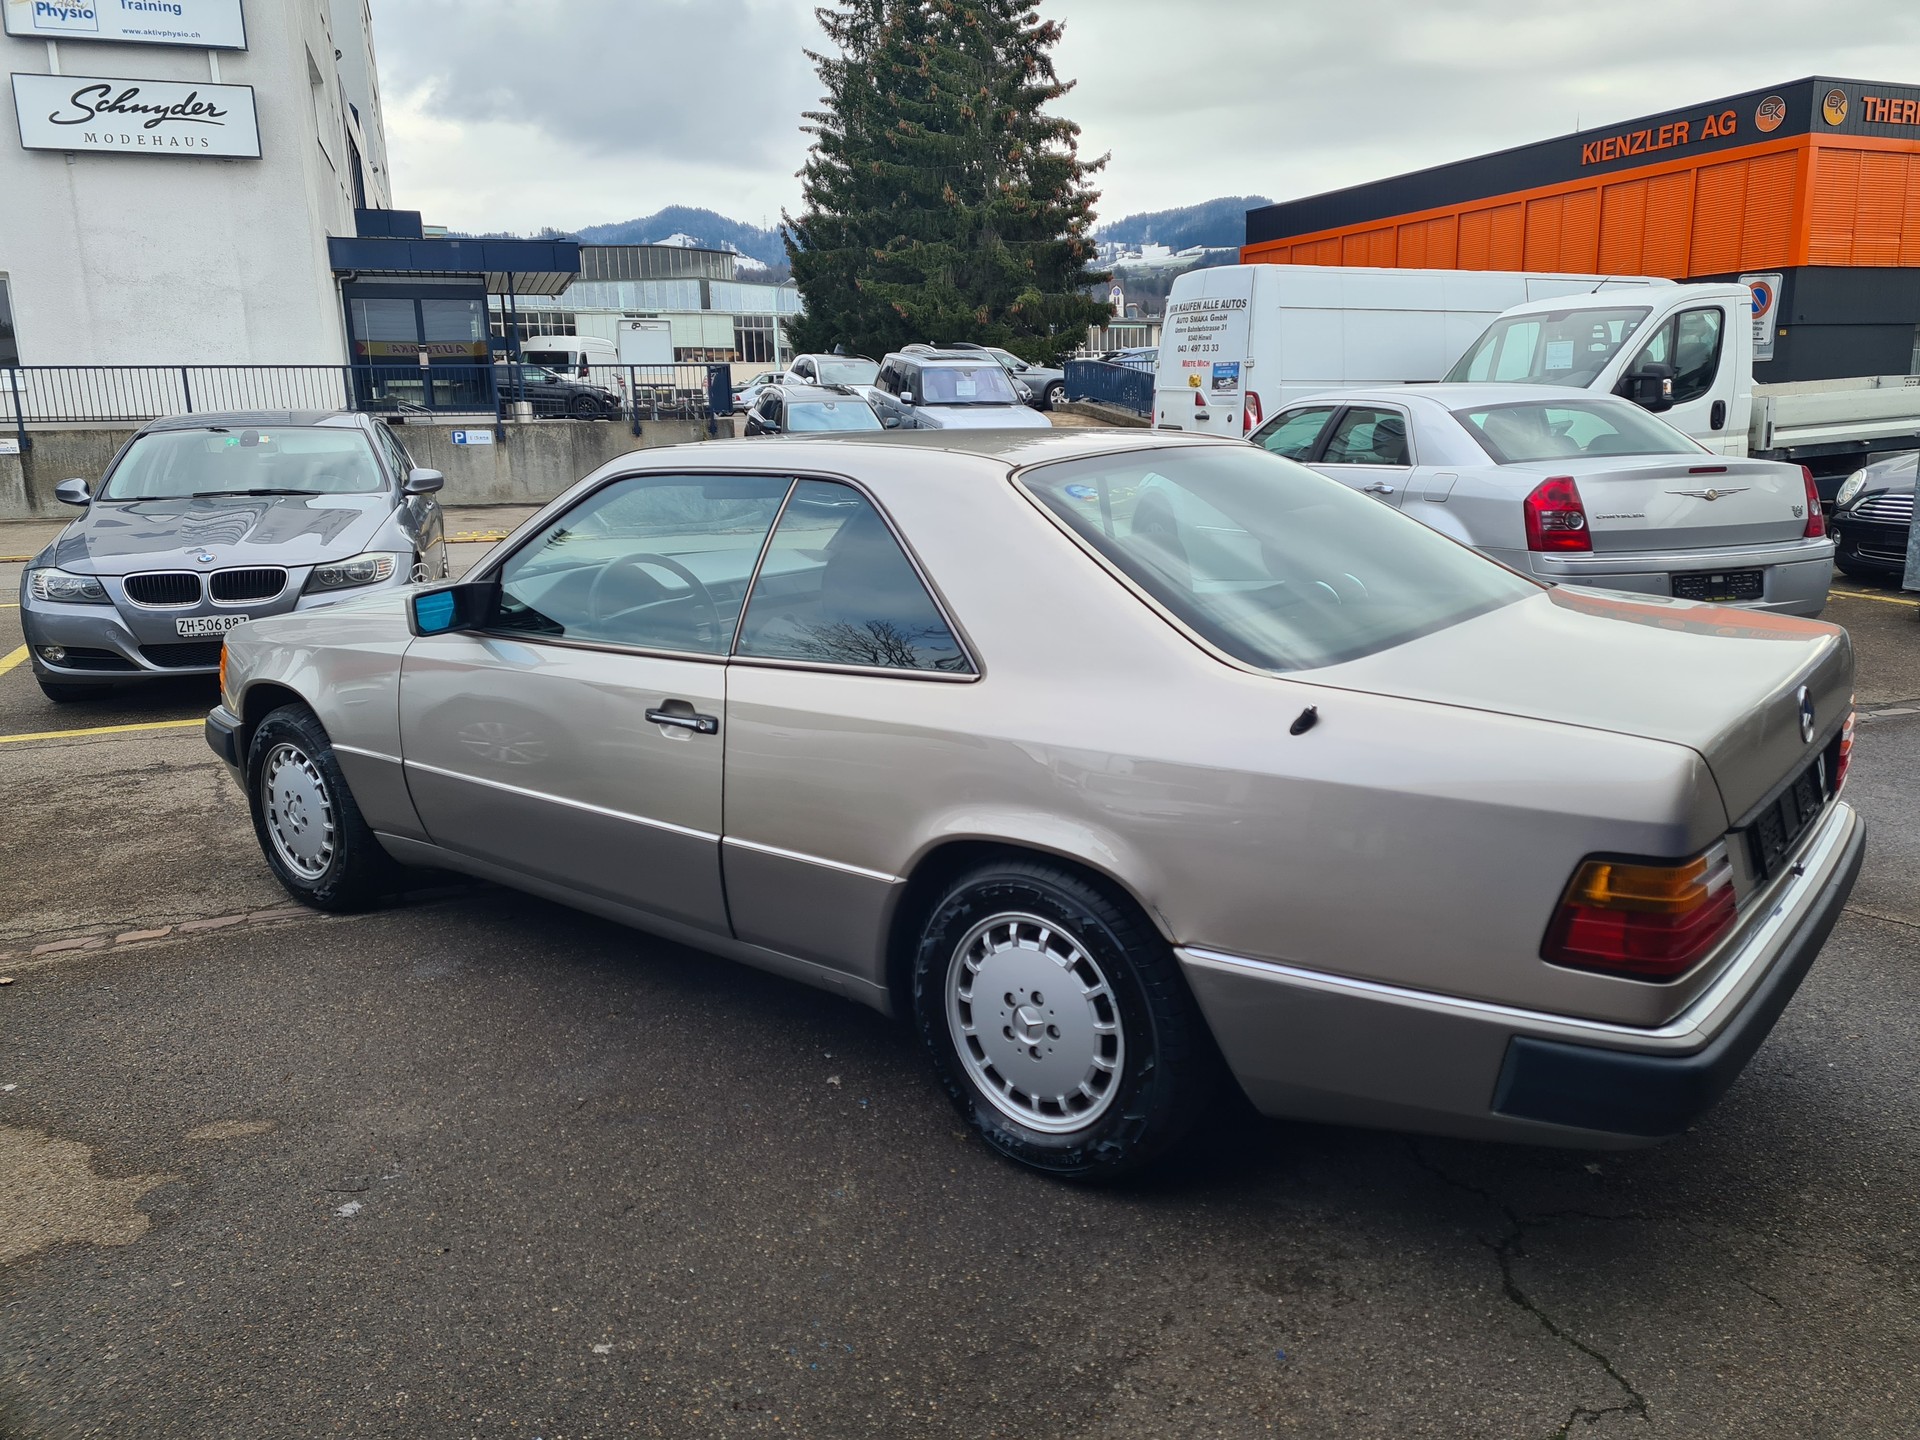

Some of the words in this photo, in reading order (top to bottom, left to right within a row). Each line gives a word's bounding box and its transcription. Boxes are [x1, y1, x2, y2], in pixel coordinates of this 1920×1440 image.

[36, 1, 94, 21] Physio
[120, 0, 182, 15] Training
[121, 27, 201, 38] www.aktivphysio.ch
[49, 84, 228, 129] Schnyder
[84, 133, 209, 147] MODEHAUS
[1581, 121, 1690, 166] KIENZLER
[1700, 110, 1737, 140] AG
[1179, 301, 1201, 312] KAUFEN
[1202, 300, 1219, 310] ALLE
[1221, 299, 1247, 309] AUTOS
[1177, 345, 1187, 353] 043
[1191, 344, 1201, 352] 497
[1202, 344, 1210, 352] 33
[1211, 344, 1219, 352] 33
[454, 432, 464, 443] P
